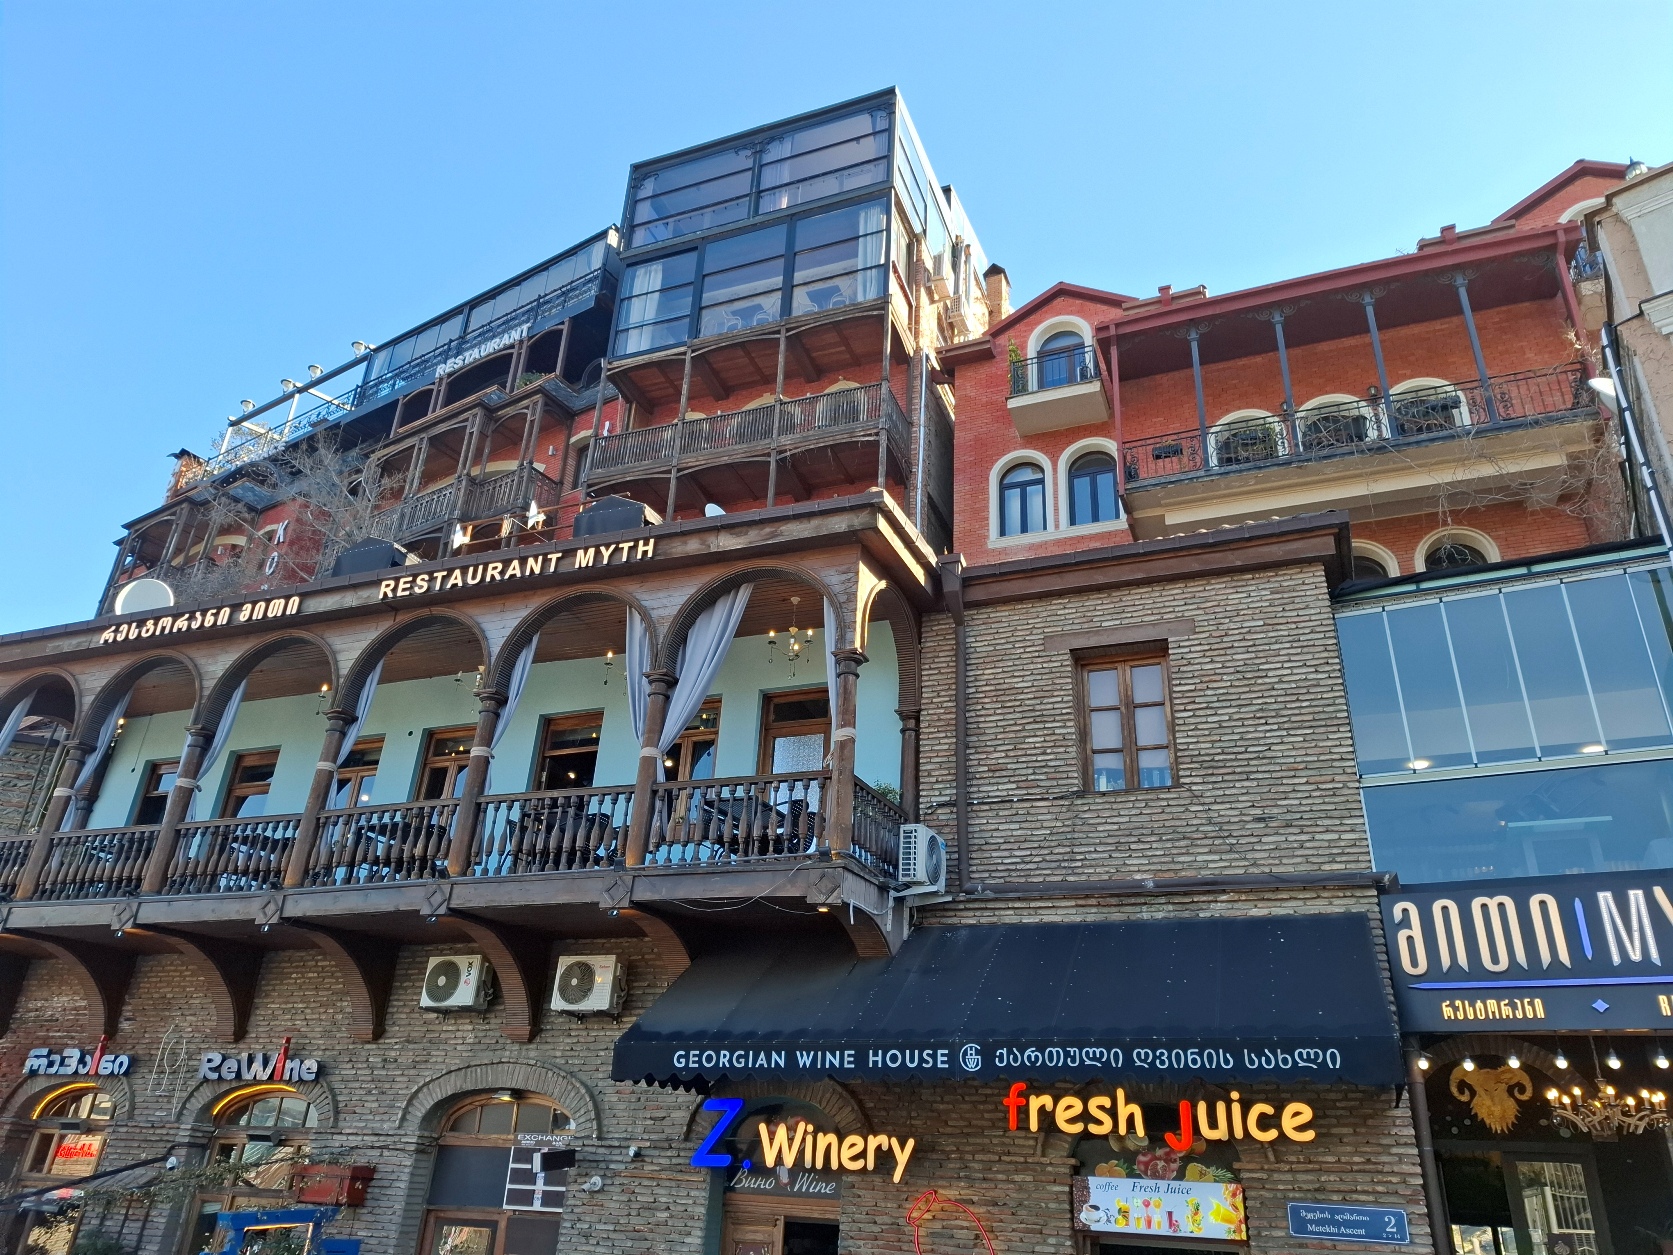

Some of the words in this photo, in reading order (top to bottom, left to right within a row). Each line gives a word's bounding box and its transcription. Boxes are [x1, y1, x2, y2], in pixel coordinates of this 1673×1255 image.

[435, 323, 532, 378] RESTAURANT
[379, 553, 562, 599] RESTAURANT
[574, 538, 655, 569] MYTH
[100, 607, 231, 644] რესტორანი
[239, 596, 300, 622] მითი
[465, 960, 474, 978] VOX
[199, 1036, 319, 1082] ReWine
[673, 1049, 785, 1069] GEORGIAN
[796, 1049, 855, 1069] WINE
[868, 1049, 948, 1069] HOUSE
[995, 1047, 1123, 1068] ქართული
[1133, 1047, 1234, 1070] ღვინის
[1244, 1047, 1341, 1070] სახლი
[1002, 1082, 1145, 1137] fresh
[1164, 1089, 1316, 1152] Juice
[758, 1121, 915, 1184] Winery
[731, 1168, 775, 1189] Вино
[793, 1171, 836, 1194] Wine
[1095, 1181, 1119, 1191] coffee
[1131, 1181, 1160, 1194] Fresh
[1163, 1183, 1192, 1195] Juice
[1306, 1223, 1338, 1233] Metekhi
[1339, 1226, 1366, 1235] Ascent
[1384, 1215, 1397, 1232] 2
